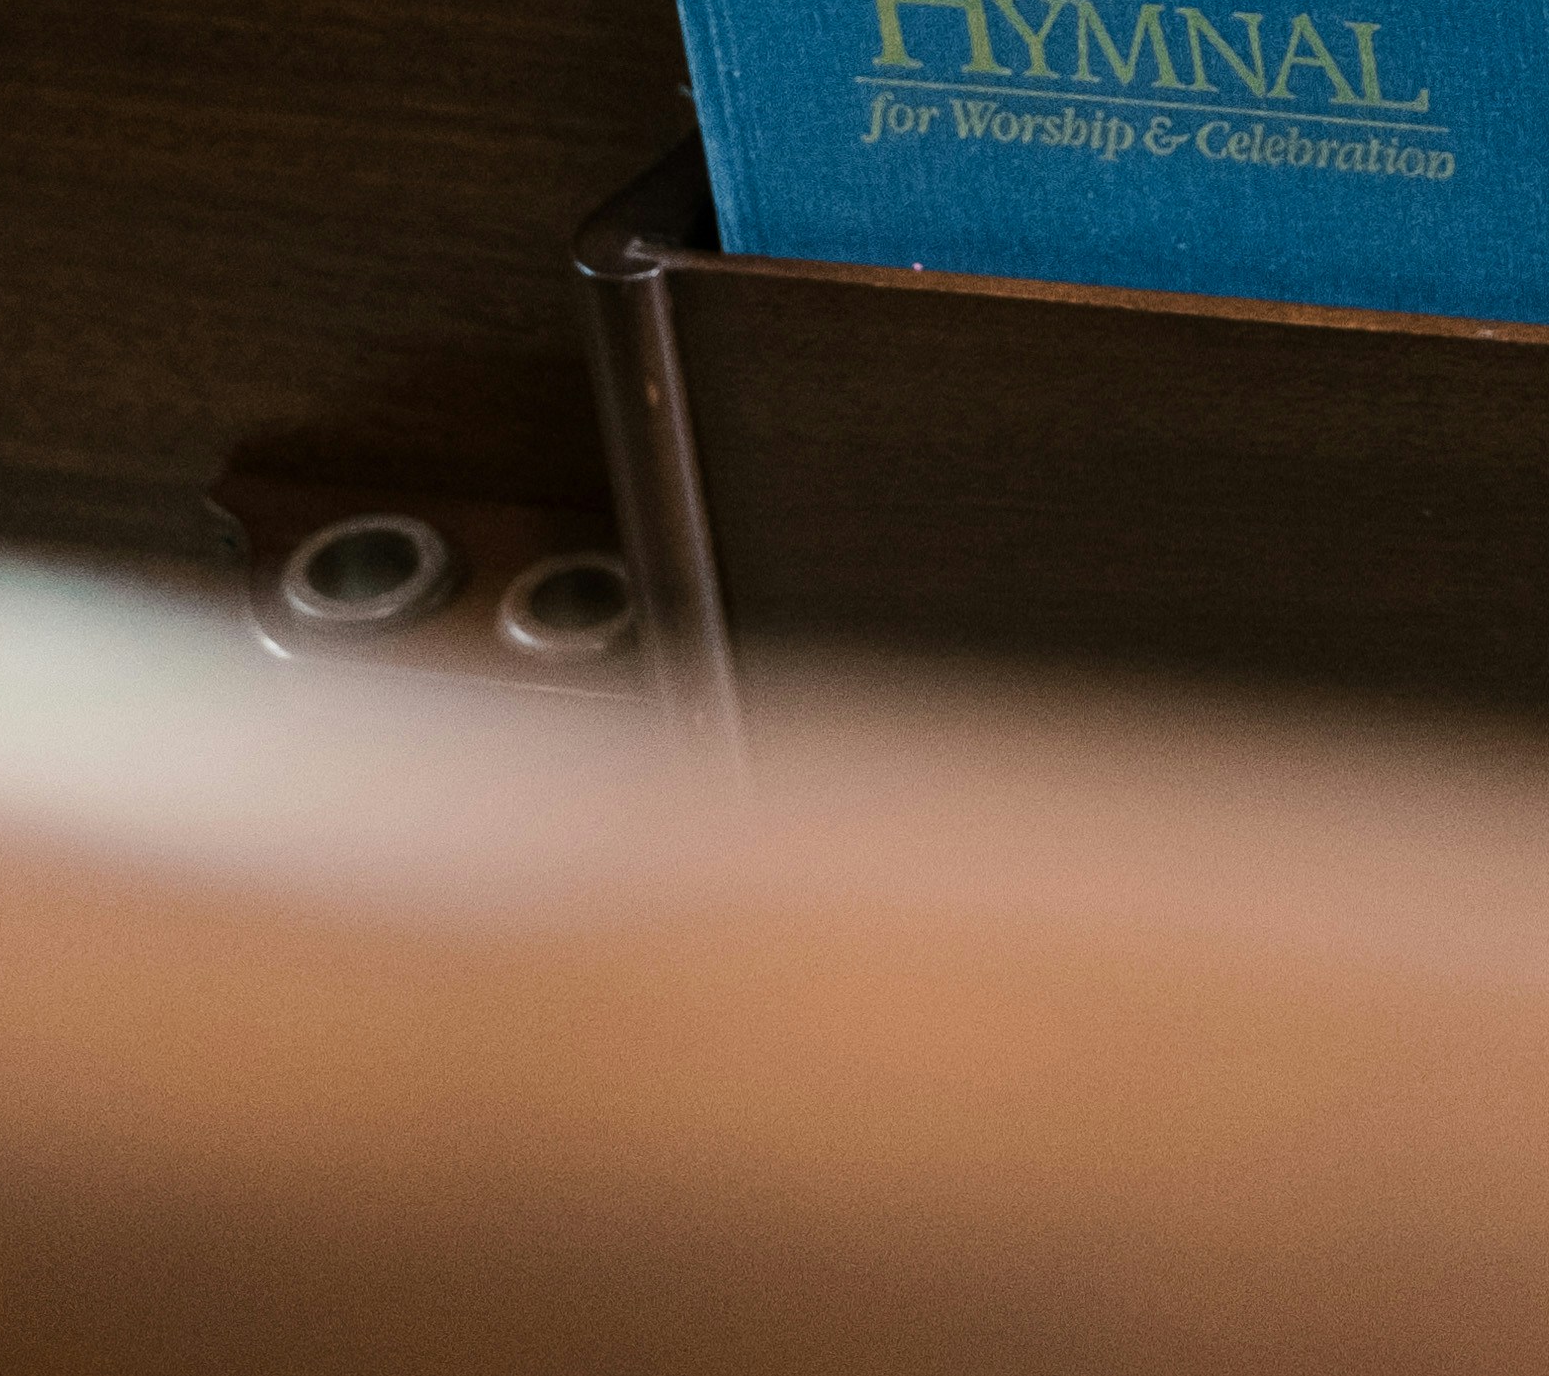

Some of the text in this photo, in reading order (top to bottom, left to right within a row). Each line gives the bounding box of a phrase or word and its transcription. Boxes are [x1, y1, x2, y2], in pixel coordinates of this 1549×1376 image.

[861, 90, 1456, 180] for Worship & Celebration
